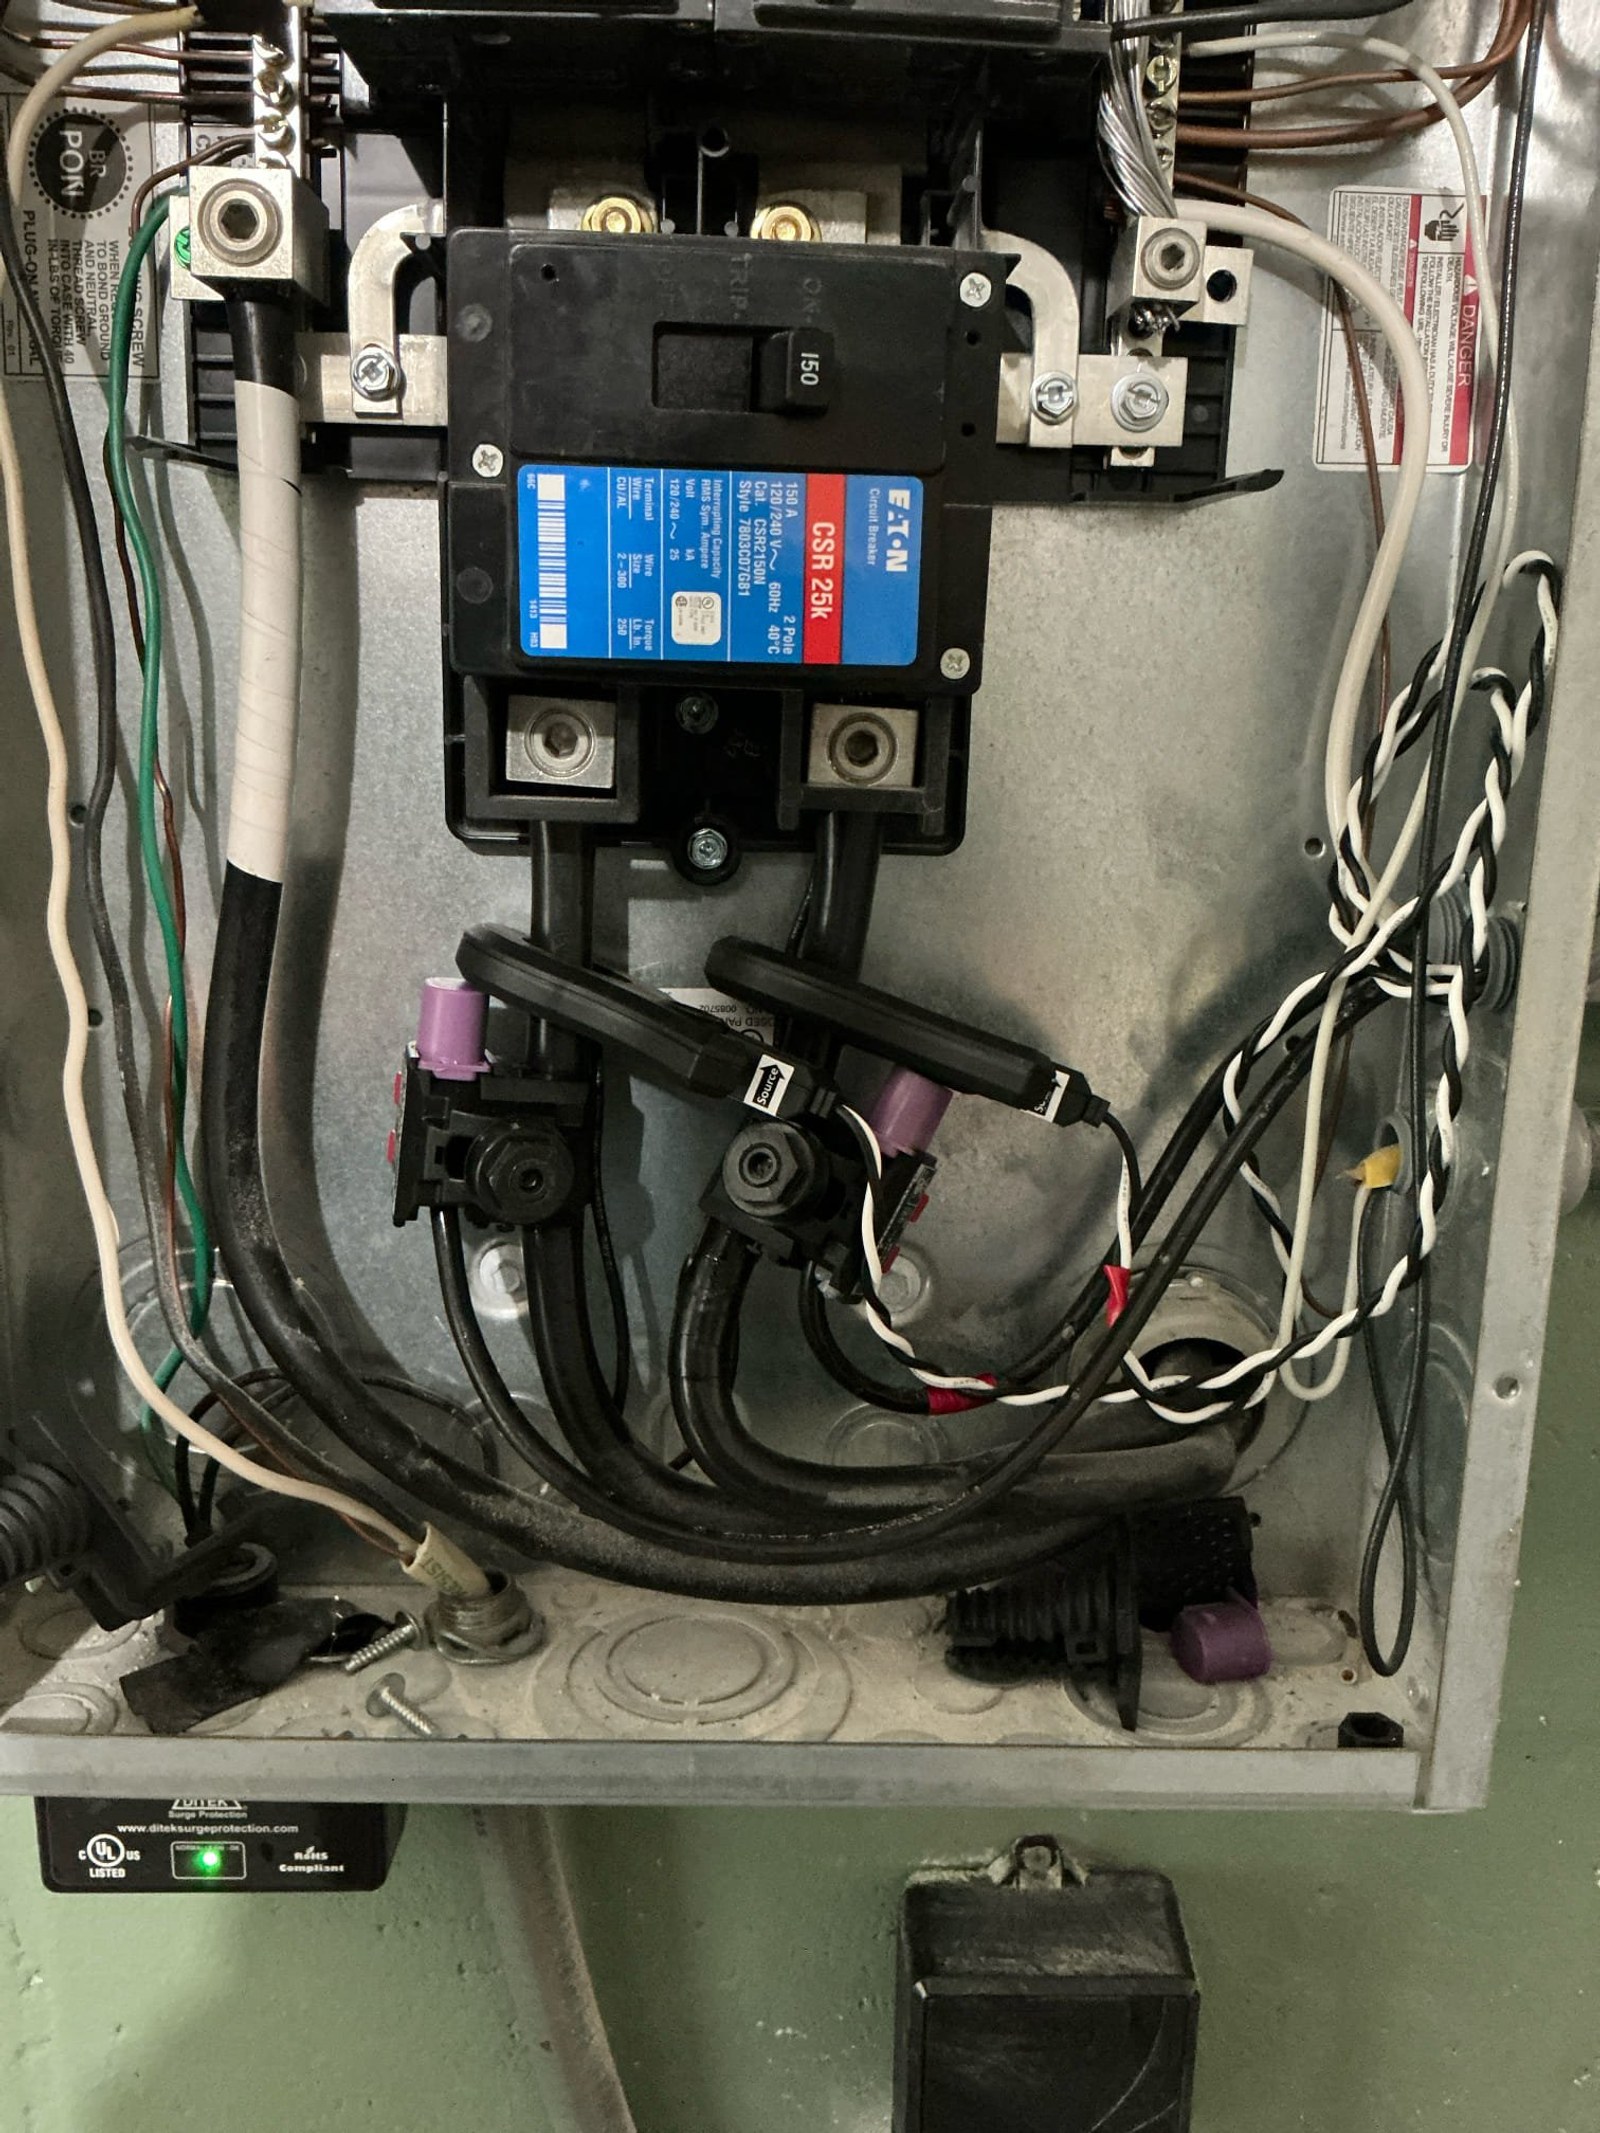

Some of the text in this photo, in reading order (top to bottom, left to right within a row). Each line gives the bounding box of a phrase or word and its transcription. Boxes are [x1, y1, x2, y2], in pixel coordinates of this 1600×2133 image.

[58, 130, 84, 196] PON
[89, 150, 107, 178] BR
[22, 210, 38, 286] PLUG-ON
[48, 239, 59, 282] IN-LBS
[84, 240, 96, 268] AND
[108, 240, 120, 280] WHEN
[49, 287, 60, 304] OF
[60, 240, 74, 364] INTO CASE WITH 40
[72, 240, 86, 346] THREAD SCREW
[97, 240, 110, 361] TO BOND GROUND
[131, 308, 144, 368] SCREW
[1457, 304, 1476, 386] DANGER
[800, 352, 819, 386] 150
[1446, 358, 1454, 384] CAUSE
[1444, 384, 1453, 413] SEVERE
[616, 476, 627, 509] CU/AL
[632, 477, 642, 500] Wire
[644, 478, 654, 520] Terminal
[669, 478, 680, 520] 120/240
[685, 479, 695, 498] Volt
[786, 482, 798, 518] 150 A
[699, 479, 710, 569] RMS Sym. Ampere
[768, 482, 782, 536] 120/240
[867, 488, 880, 565] Circuit Breaker
[710, 479, 722, 579] Interrupting Capacity
[737, 480, 752, 596] Style 7803C07G81
[753, 480, 767, 585] Cat. CSR2150N
[885, 489, 910, 572] EATON
[632, 554, 642, 574] Size
[644, 554, 654, 577] Wire
[670, 548, 680, 560] 25
[685, 549, 694, 561] kA
[810, 522, 835, 619] CSR 25k
[768, 582, 780, 613] 60Hz
[617, 618, 627, 636] 250
[632, 618, 642, 649] Lb. In.
[642, 619, 654, 651] Torque
[782, 615, 796, 655] 2 Pole
[756, 1068, 778, 1105] Source
[117, 1824, 298, 1834] www.diteksurgeprotection.com
[168, 1810, 248, 1820] Surge Protection
[89, 1868, 126, 1878] LISTED
[279, 1864, 344, 1874] Compliant
